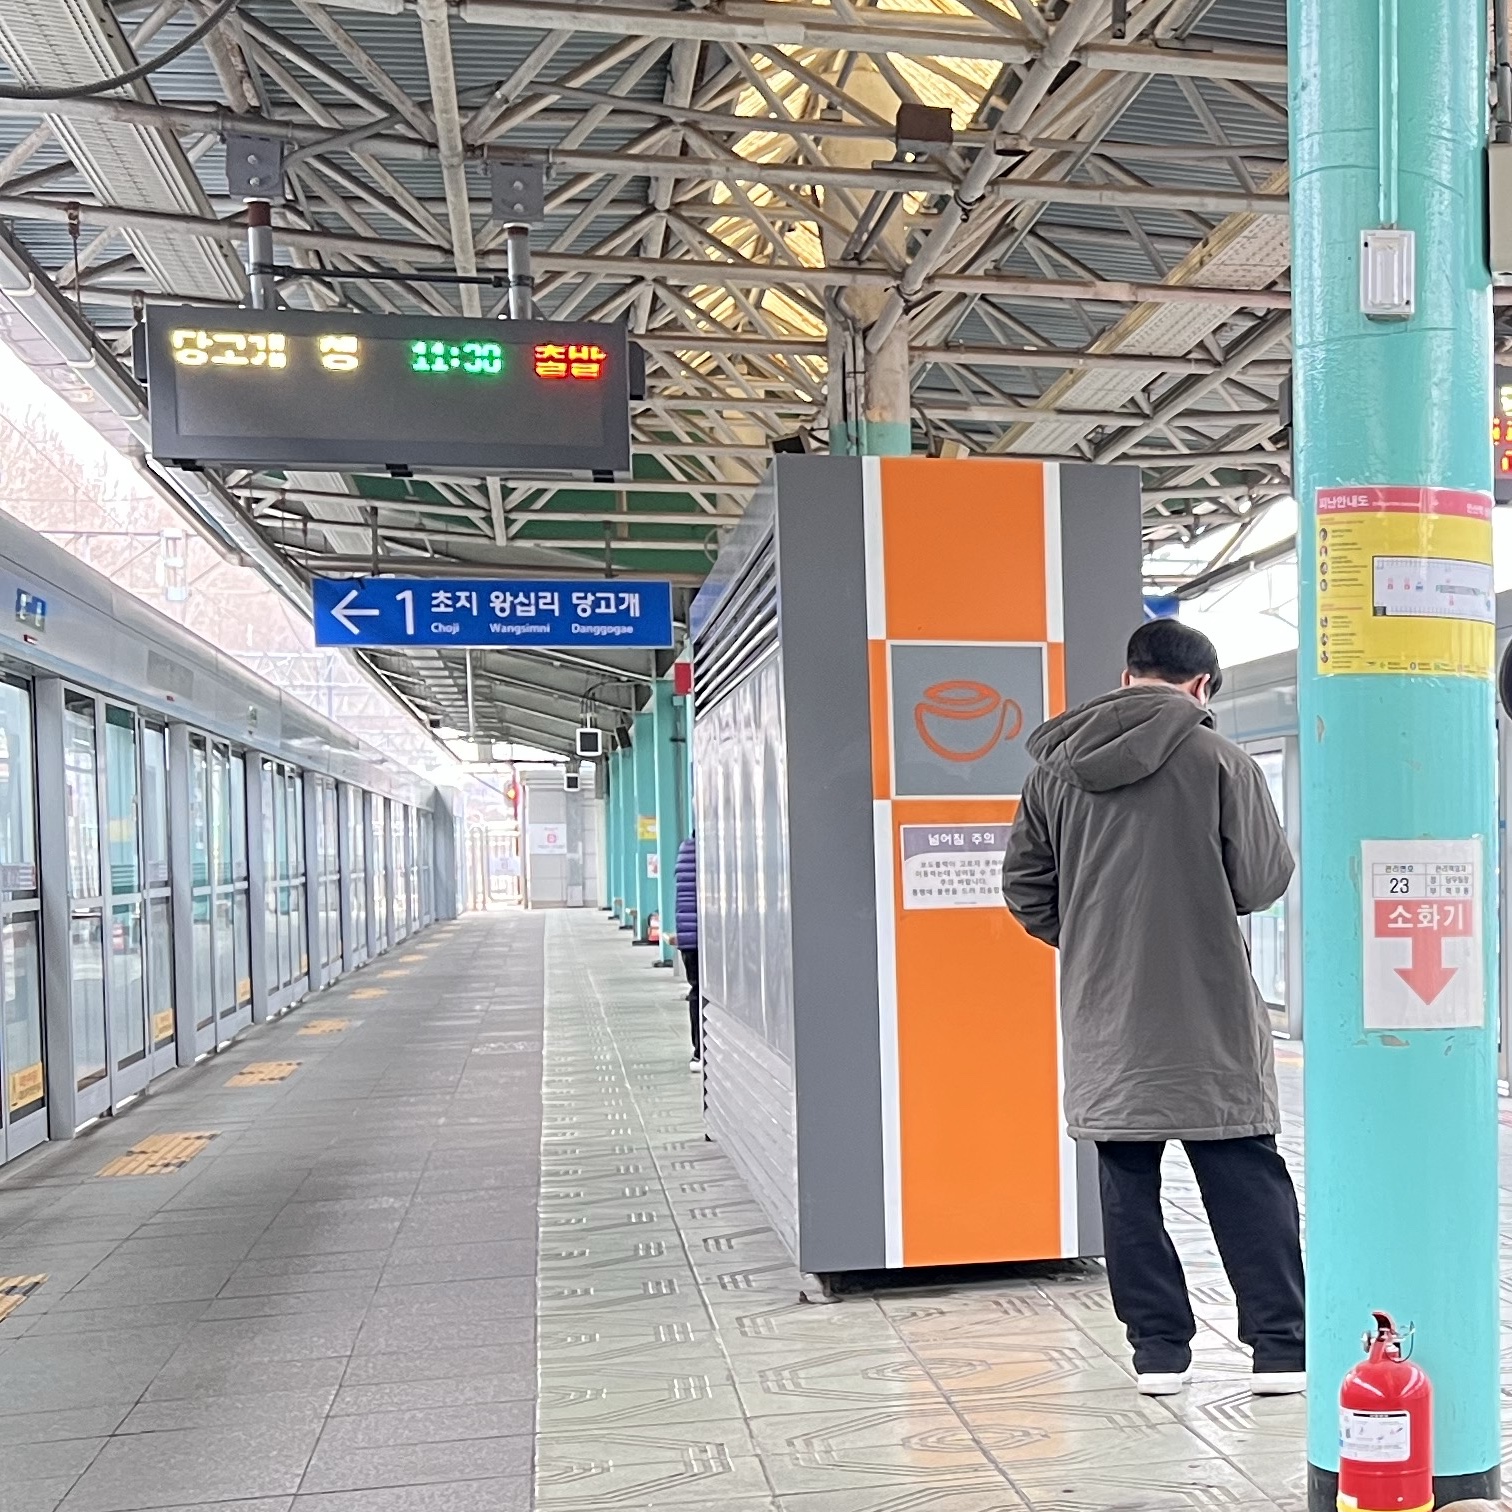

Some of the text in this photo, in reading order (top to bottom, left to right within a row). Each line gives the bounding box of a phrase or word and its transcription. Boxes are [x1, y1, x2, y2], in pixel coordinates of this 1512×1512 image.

[172, 329, 287, 368] 당고개
[412, 341, 502, 373] 11:30
[534, 343, 607, 378] 출발
[395, 590, 640, 635] 1 초지 왕십리 당고개
[431, 622, 634, 635] Choji Wangsimni Danggogae
[972, 832, 995, 845] 주의
[1390, 877, 1409, 894] 23
[1387, 904, 1463, 930] 소화기
